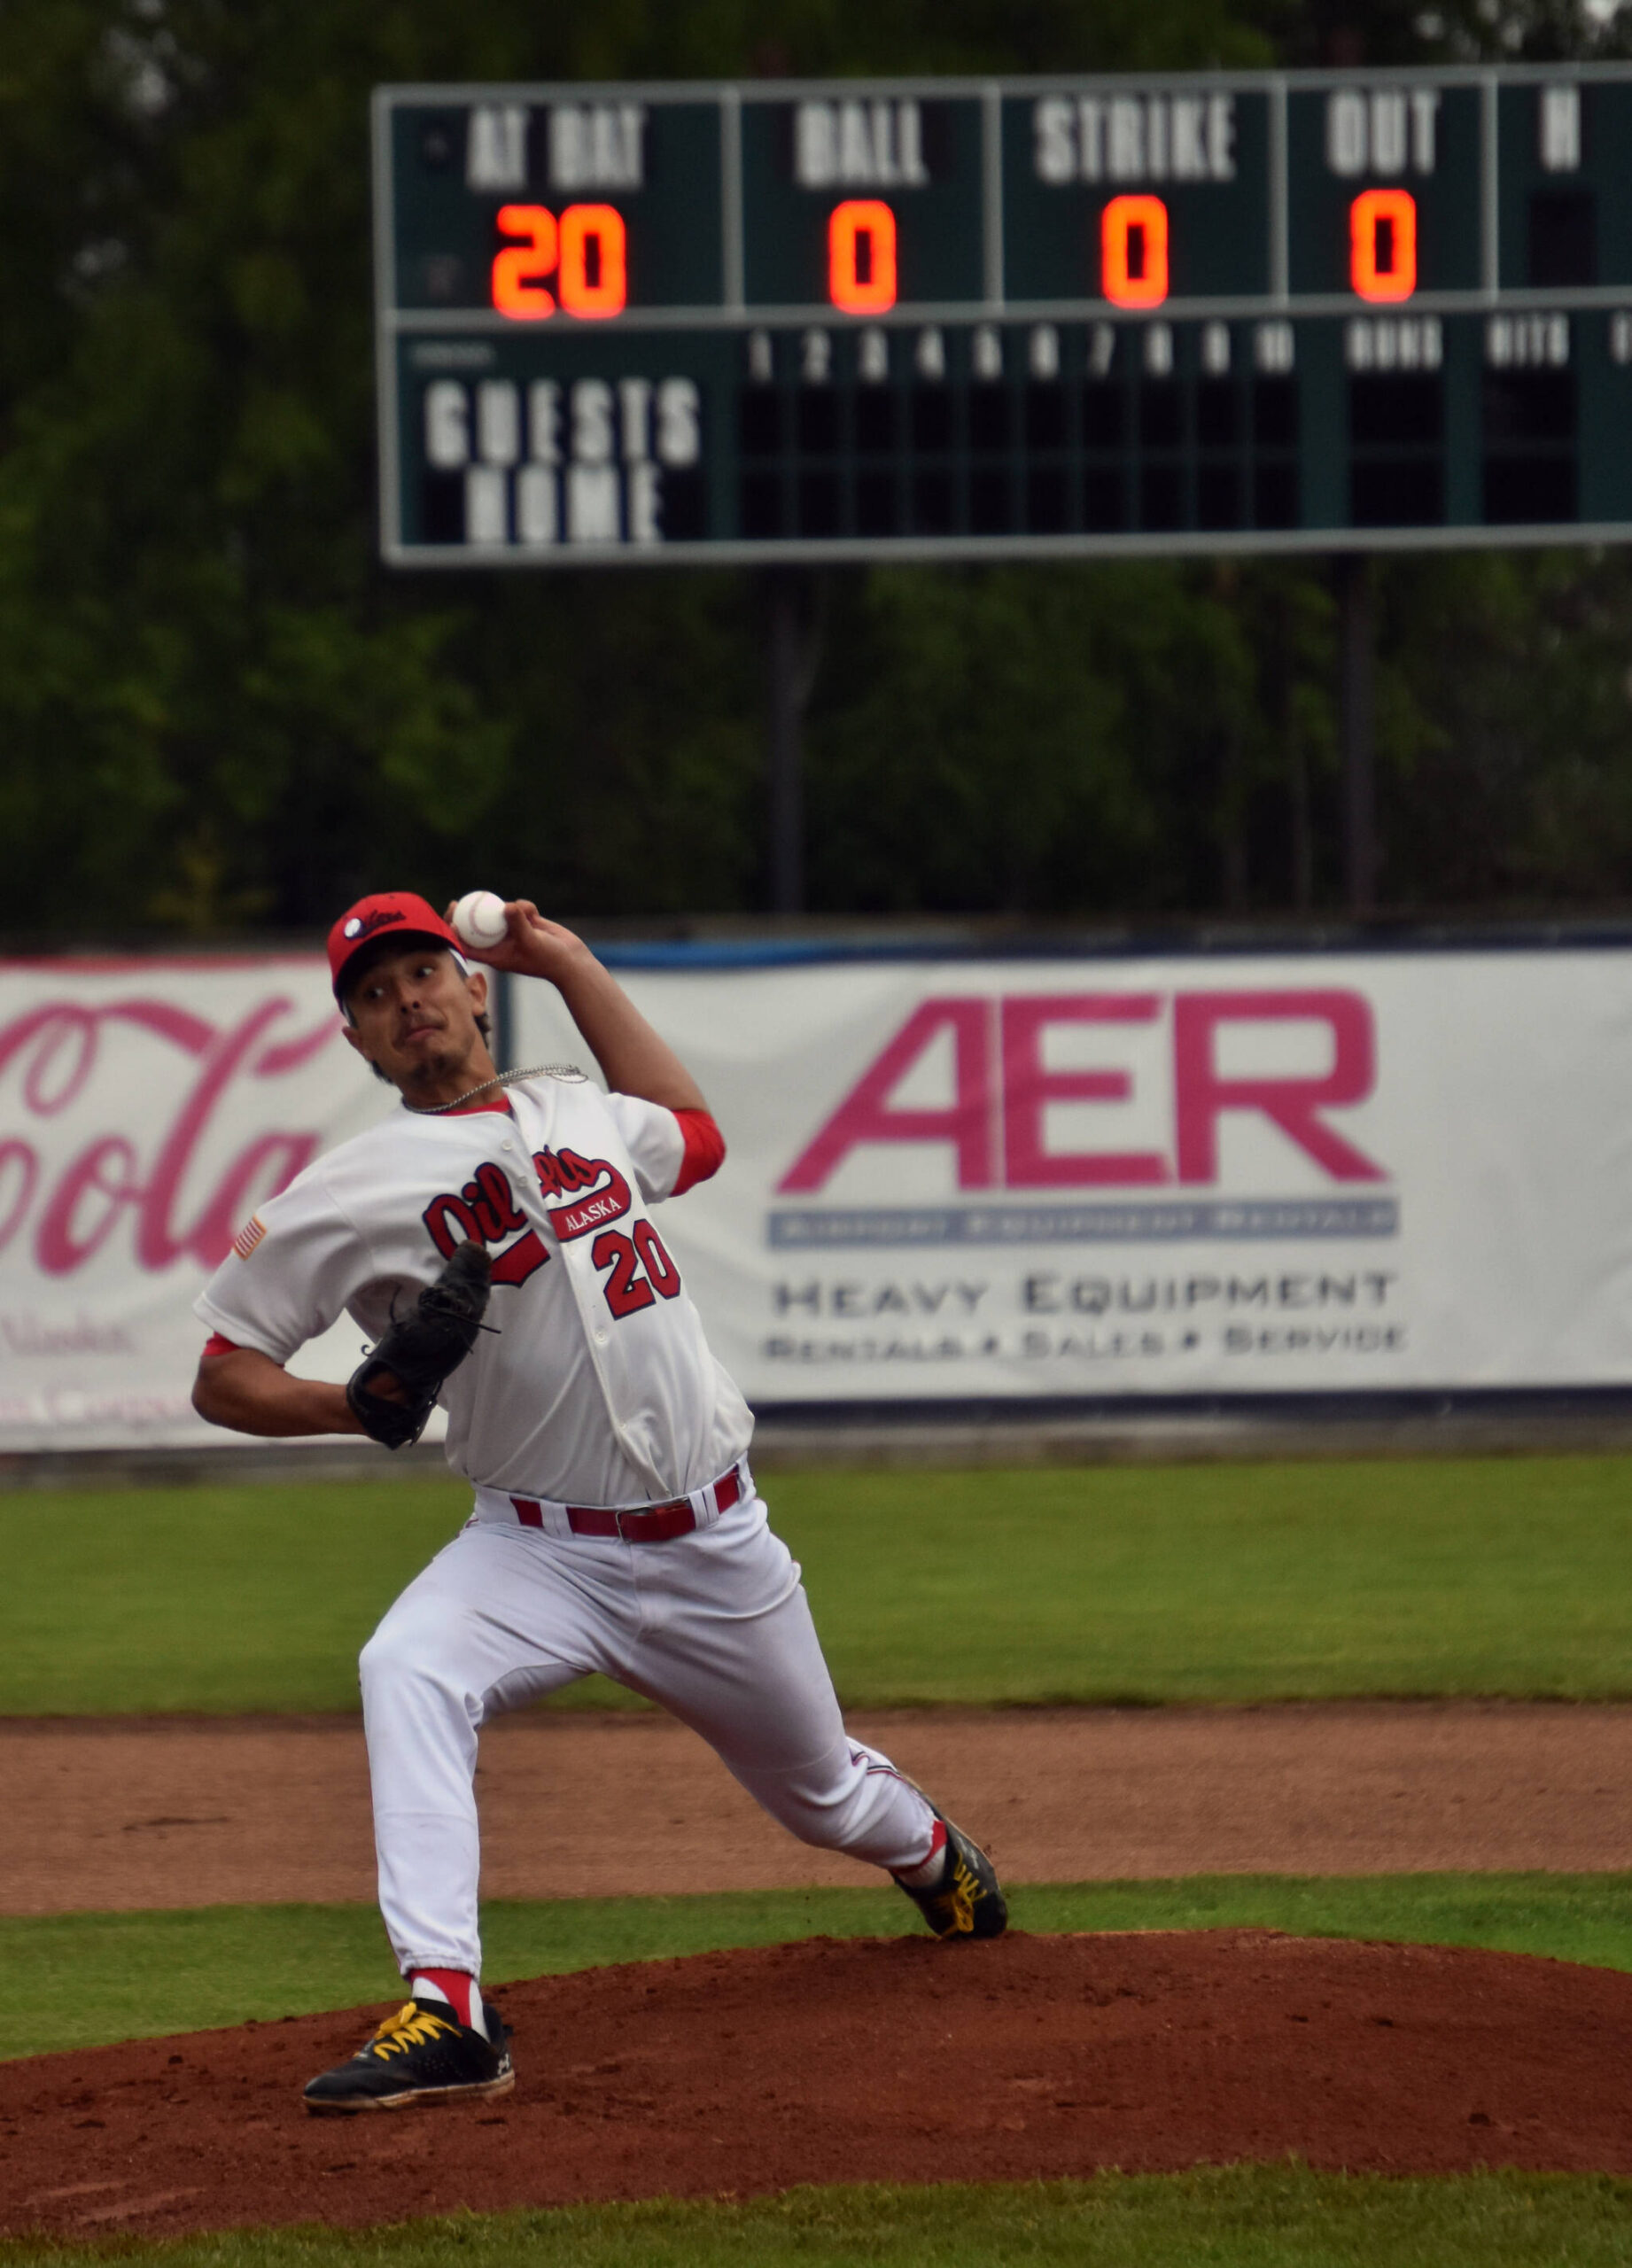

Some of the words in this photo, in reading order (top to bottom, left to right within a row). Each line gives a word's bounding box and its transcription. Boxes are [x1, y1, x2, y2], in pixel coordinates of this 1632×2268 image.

[468, 105, 528, 190] AT
[549, 102, 646, 190] BAT
[797, 99, 927, 187] BALL
[1034, 95, 1237, 184] STRIKE
[1327, 87, 1439, 176] OUT
[492, 203, 626, 319] 20
[828, 199, 898, 315] 0
[1101, 194, 1168, 308] 0
[1350, 188, 1417, 303] 0
[424, 377, 703, 470] GUESTS
[463, 464, 664, 546] HOME
[771, 987, 1393, 1196] AER
[565, 1196, 623, 1232] ALASKA
[591, 1218, 682, 1321] 20
[773, 1279, 991, 1320] HEAVY
[1021, 1271, 1400, 1320] EQUIPMENT
[1022, 1329, 1168, 1361] SALES
[1224, 1324, 1411, 1355] SERVICE
